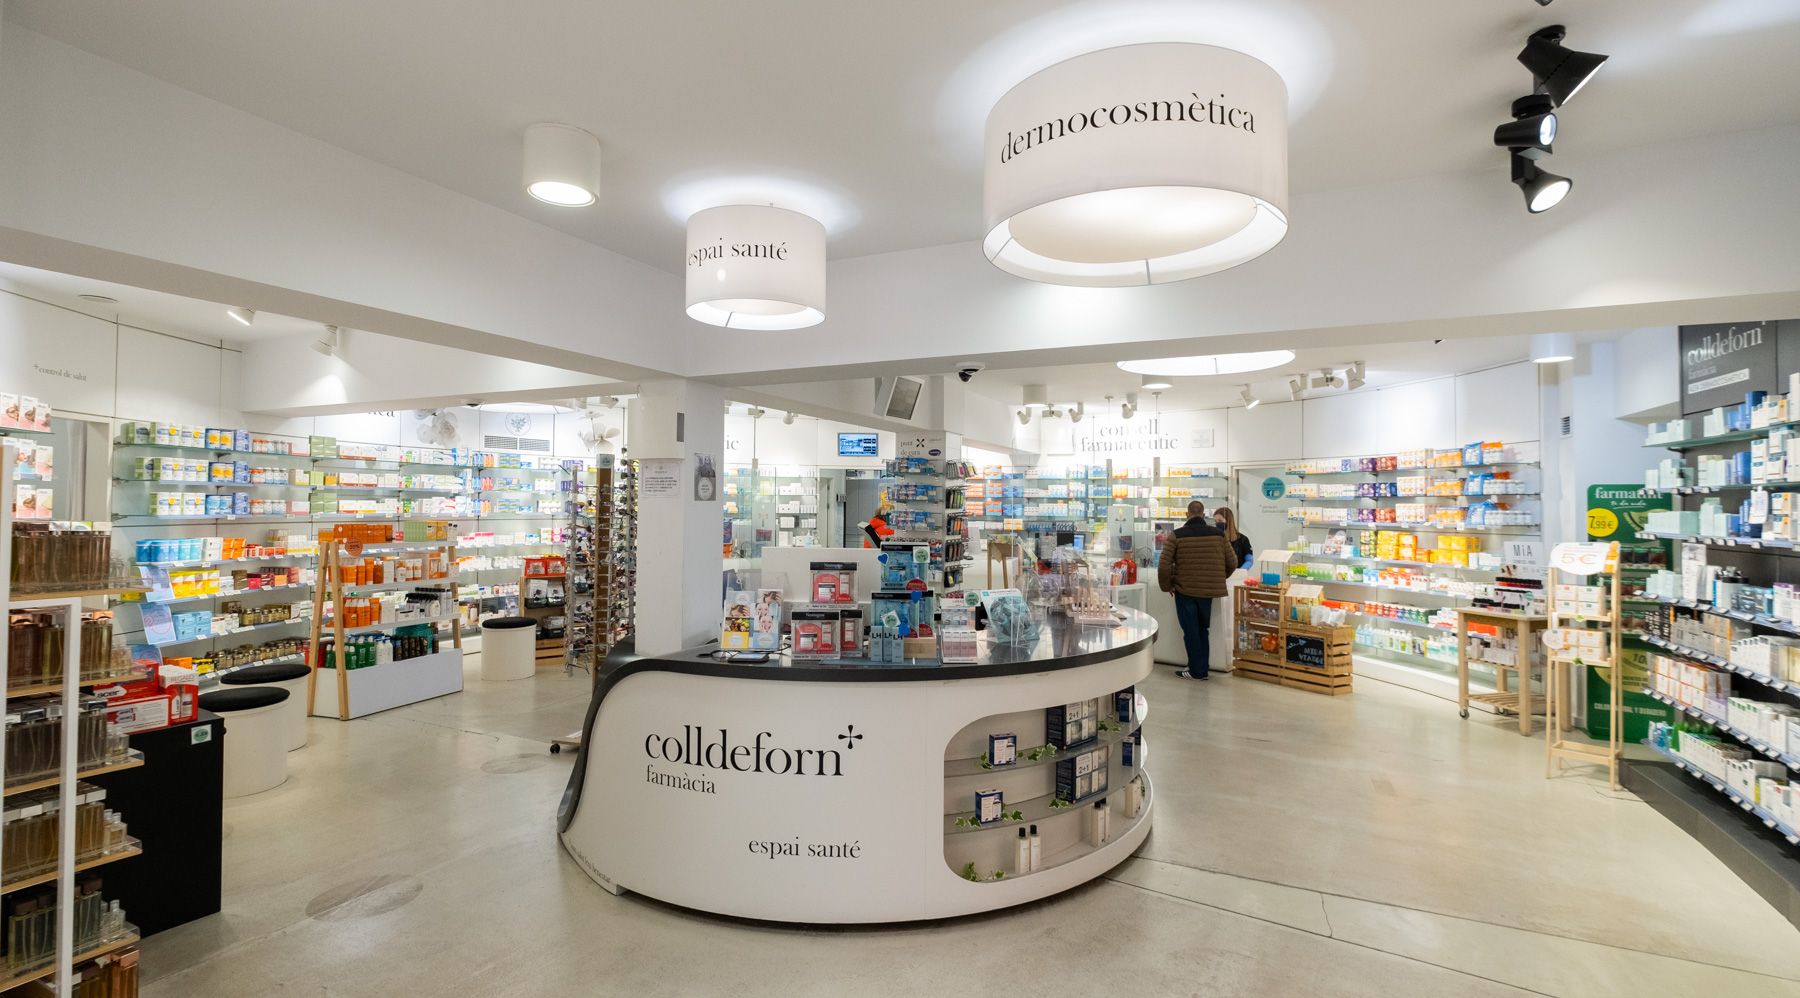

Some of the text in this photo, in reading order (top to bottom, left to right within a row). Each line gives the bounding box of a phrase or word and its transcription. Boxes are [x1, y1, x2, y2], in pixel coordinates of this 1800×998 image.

[1001, 93, 1256, 164] dermocosmètica
[688, 237, 788, 267] espai santé
[1687, 326, 1763, 366] colldeforn
[1068, 711, 1080, 721] 2+1
[645, 724, 844, 777] colldeforn
[646, 764, 717, 795] farmàcia
[1078, 764, 1090, 774] 2+1
[748, 836, 862, 860] espai santé
